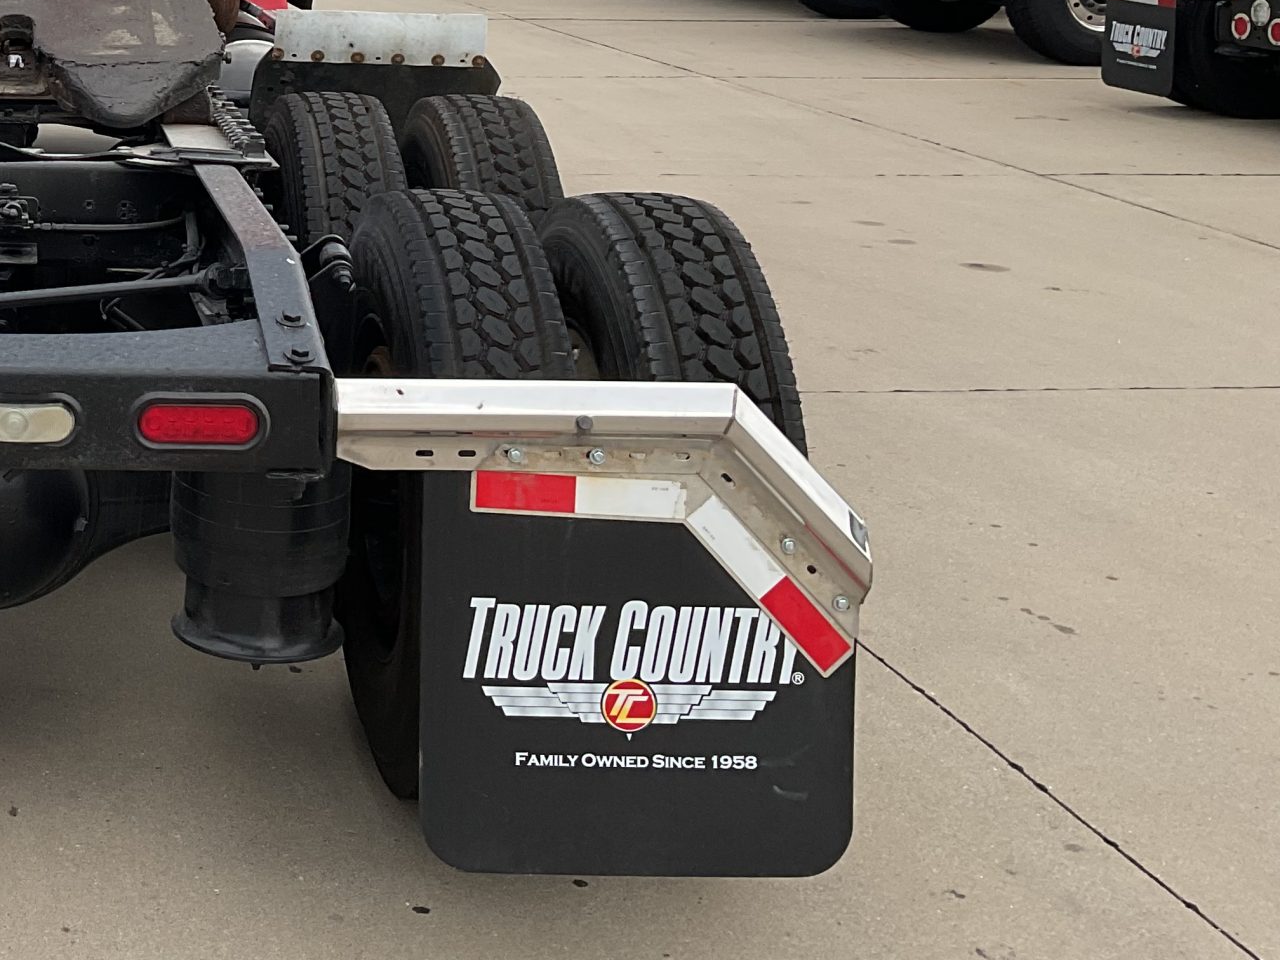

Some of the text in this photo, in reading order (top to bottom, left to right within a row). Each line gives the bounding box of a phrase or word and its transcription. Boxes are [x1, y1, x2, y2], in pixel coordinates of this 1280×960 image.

[1110, 21, 1135, 44] TRUCK
[463, 597, 607, 682] TRUCK
[515, 751, 758, 770] FAMILY OWNED SINCE 1958
